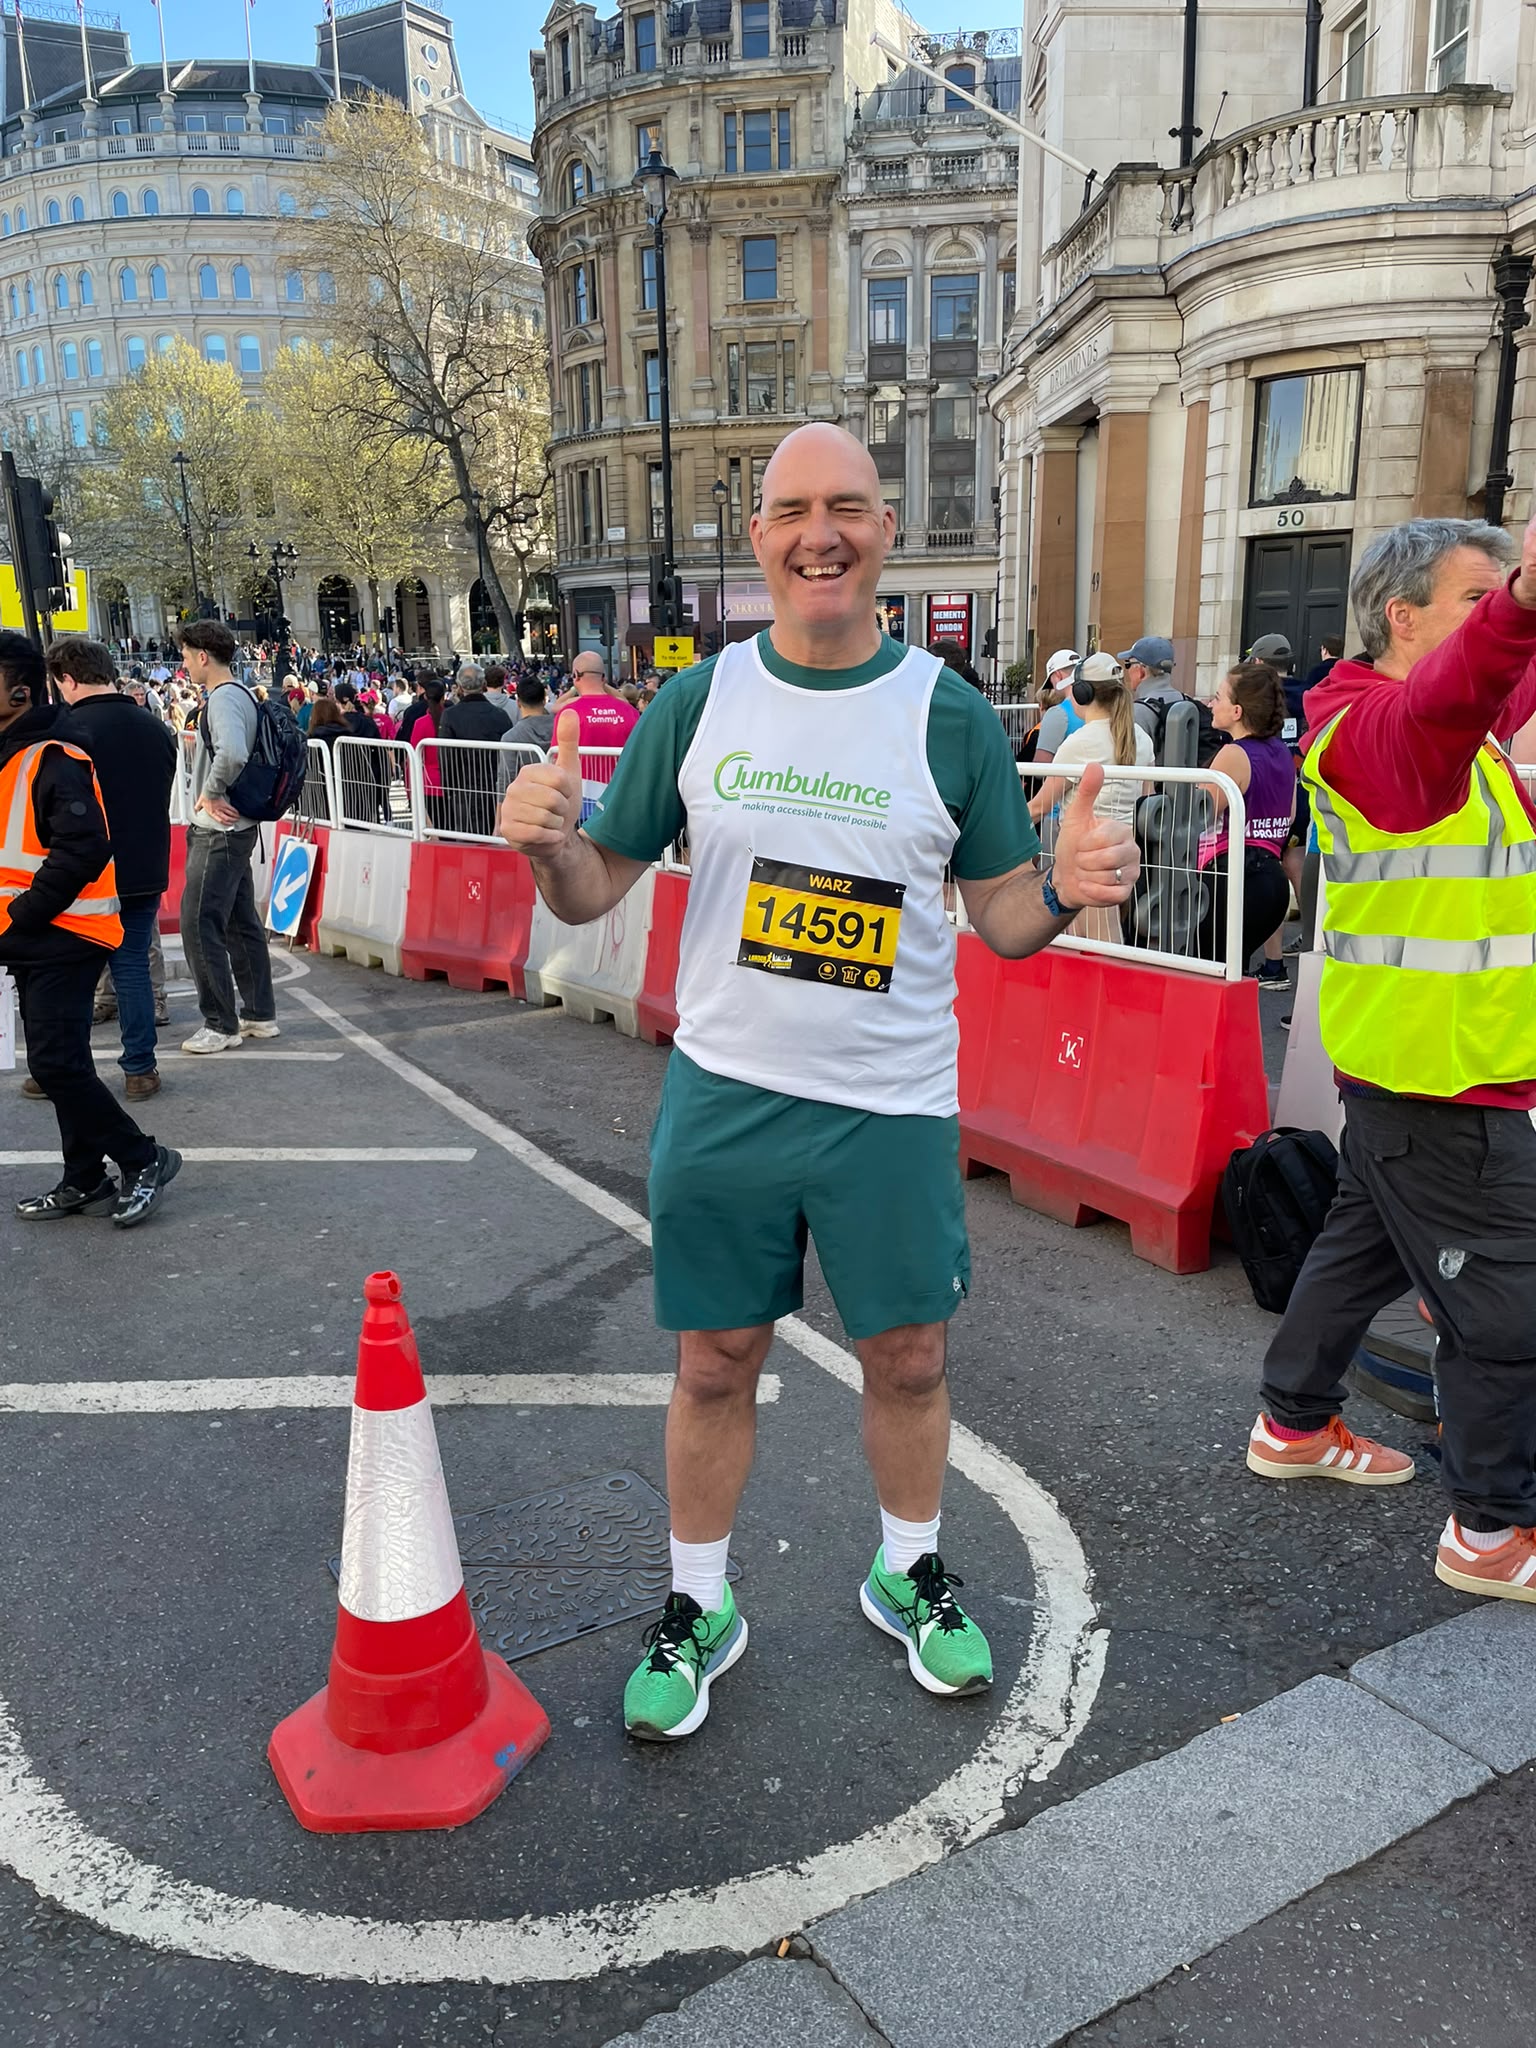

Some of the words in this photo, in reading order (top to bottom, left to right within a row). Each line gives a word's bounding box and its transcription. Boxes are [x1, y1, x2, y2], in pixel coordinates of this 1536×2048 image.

[1049, 339, 1099, 394] DRUMMONDS
[1277, 510, 1304, 527] 50
[1091, 571, 1100, 593] 49
[932, 610, 966, 620] MEMENTO
[935, 623, 963, 632] LONDON
[586, 715, 625, 725] Tommy's
[591, 707, 616, 715] Team
[727, 763, 892, 809] Jumbulance
[741, 802, 776, 815] making
[776, 804, 823, 819] accessible
[823, 811, 851, 823] travel
[850, 816, 888, 831] possible
[1252, 818, 1272, 829] THE
[809, 873, 853, 894] WARZ
[757, 896, 885, 954] 14591
